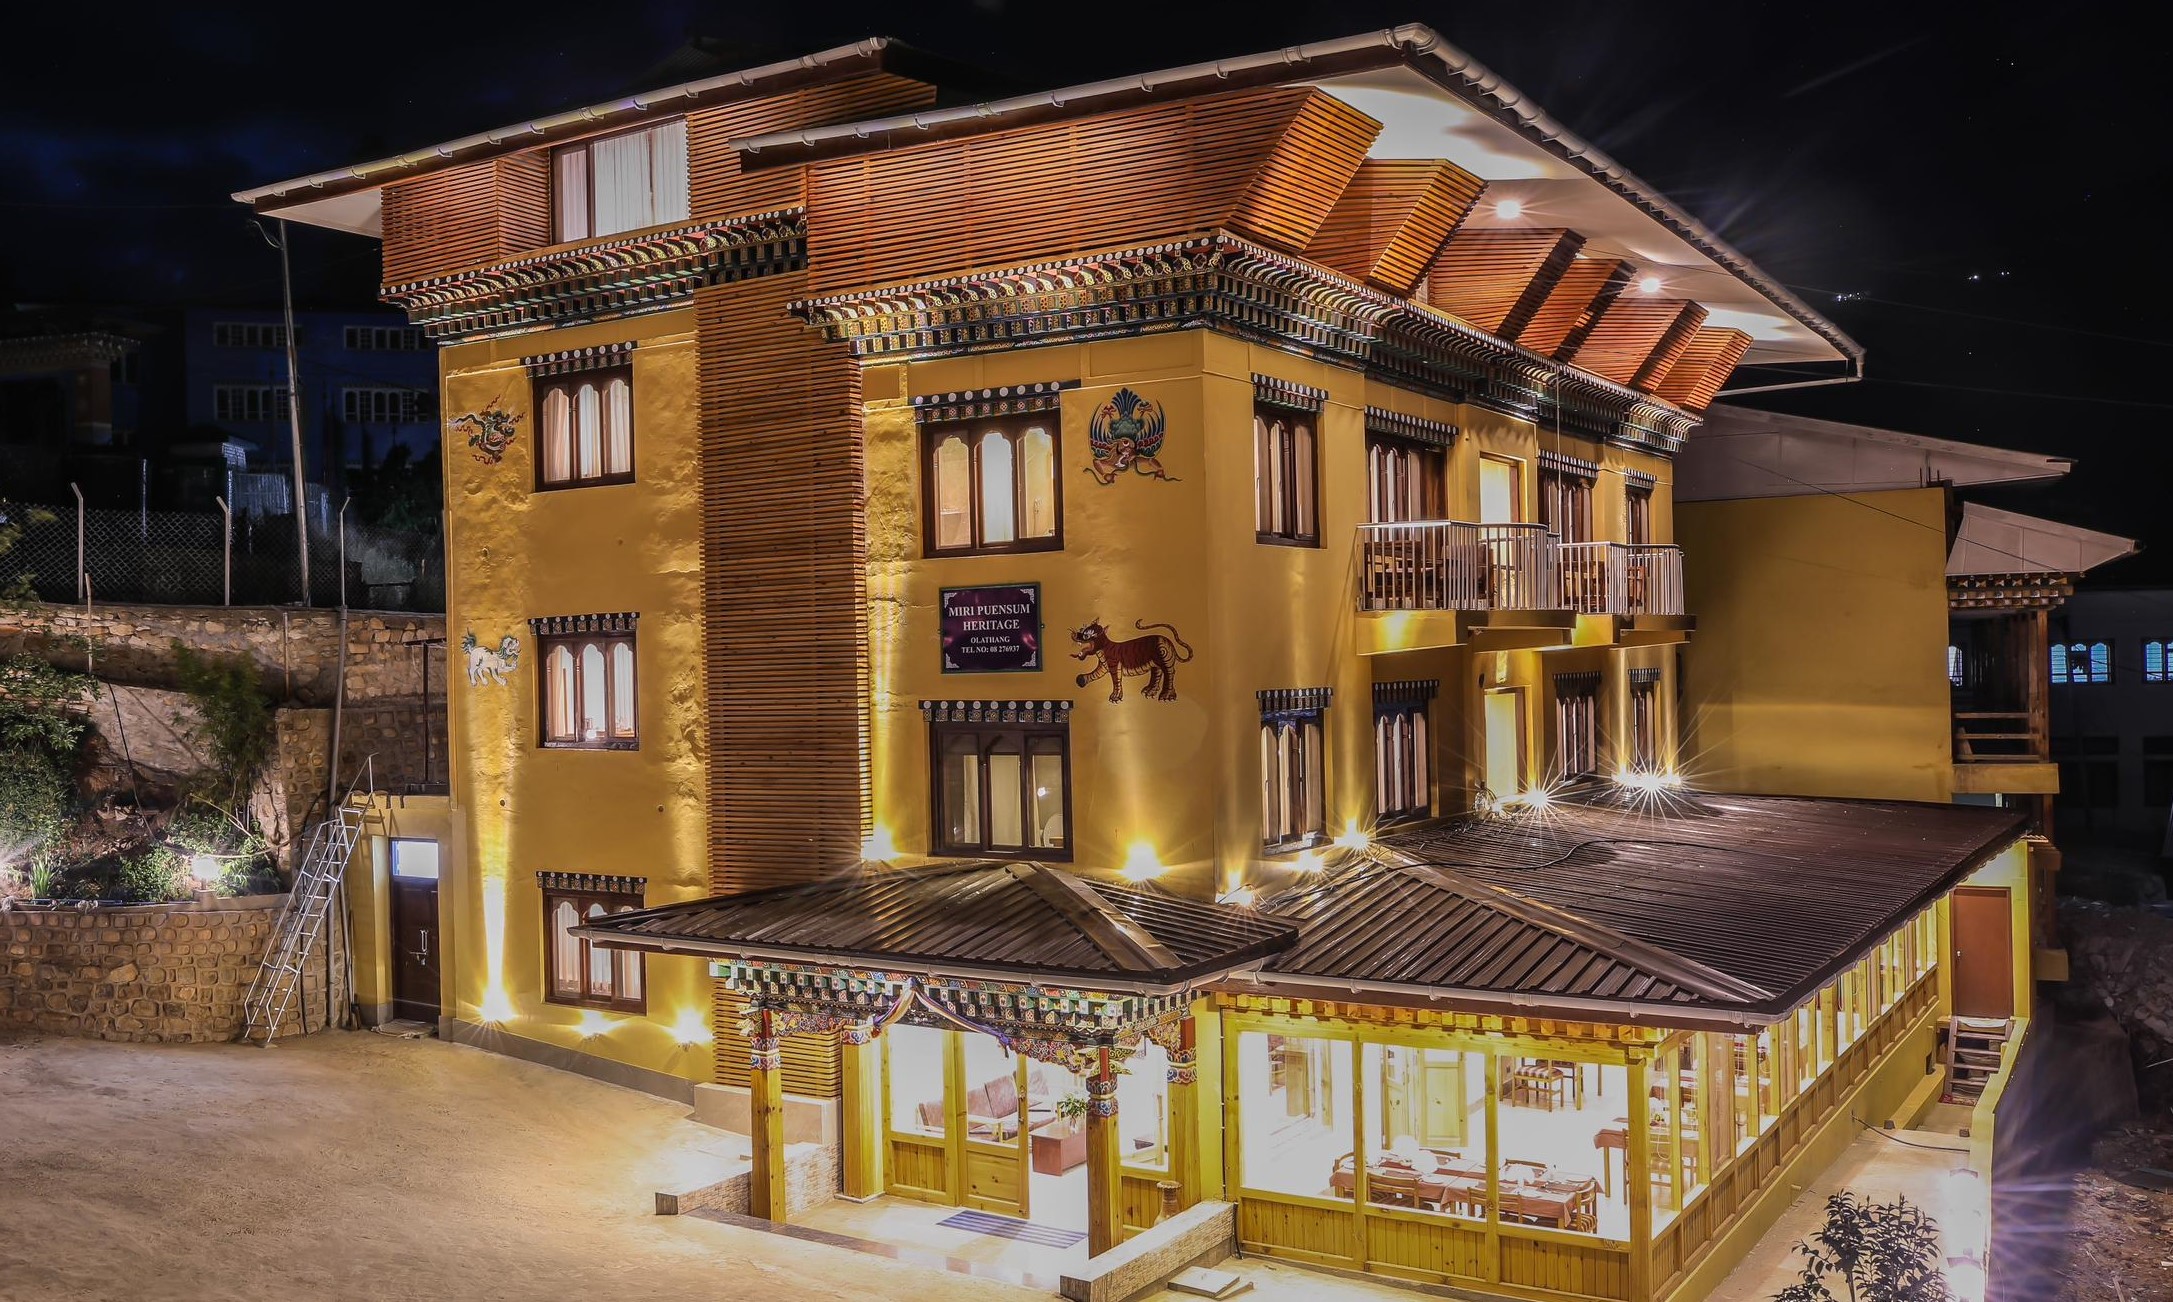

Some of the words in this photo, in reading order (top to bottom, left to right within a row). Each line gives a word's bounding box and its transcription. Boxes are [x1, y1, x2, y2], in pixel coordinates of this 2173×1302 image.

[948, 606, 974, 617] MIRI
[977, 603, 1030, 616] PUENSUM
[963, 619, 1020, 631] HERITAGE
[970, 635, 1010, 644] OLATHANG
